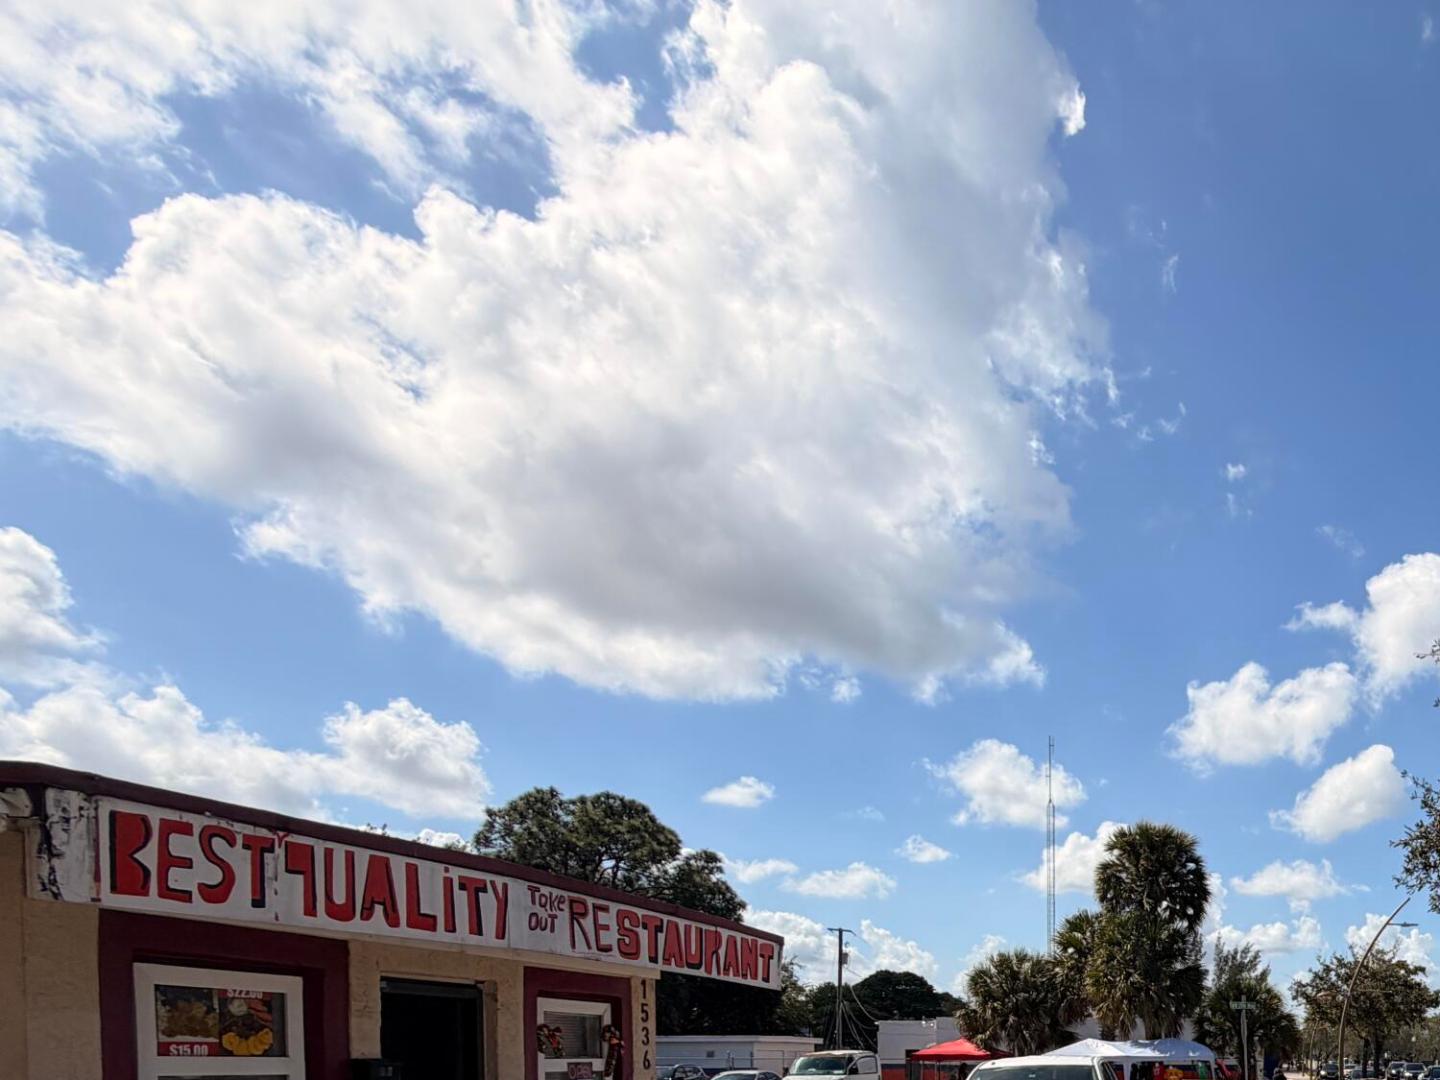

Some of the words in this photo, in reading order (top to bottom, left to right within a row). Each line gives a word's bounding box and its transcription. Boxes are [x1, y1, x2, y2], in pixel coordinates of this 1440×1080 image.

[109, 810, 275, 908] BEST
[567, 896, 774, 983] RESTAURANT
[640, 979, 651, 1070] 1536
